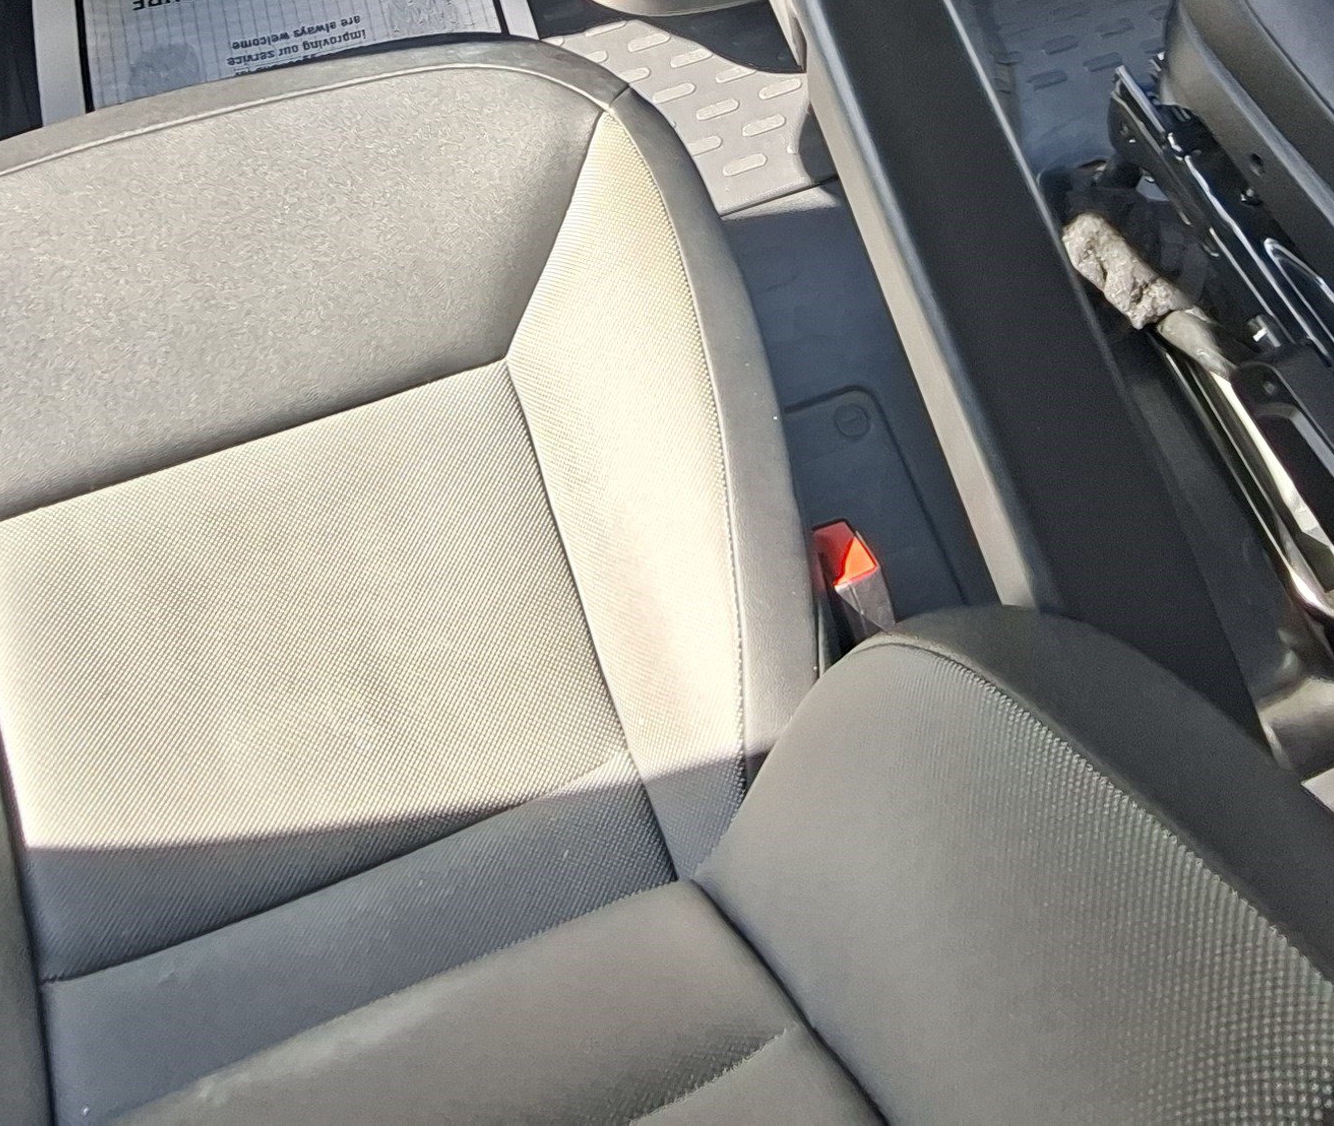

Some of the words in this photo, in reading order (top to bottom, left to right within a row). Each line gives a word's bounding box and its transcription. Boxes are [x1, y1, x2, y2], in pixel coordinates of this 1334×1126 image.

[341, 15, 360, 26] are
[293, 21, 337, 38] always
[232, 31, 290, 50] welcome
[303, 29, 366, 51] improving
[227, 49, 274, 65] service
[279, 46, 298, 57] our
